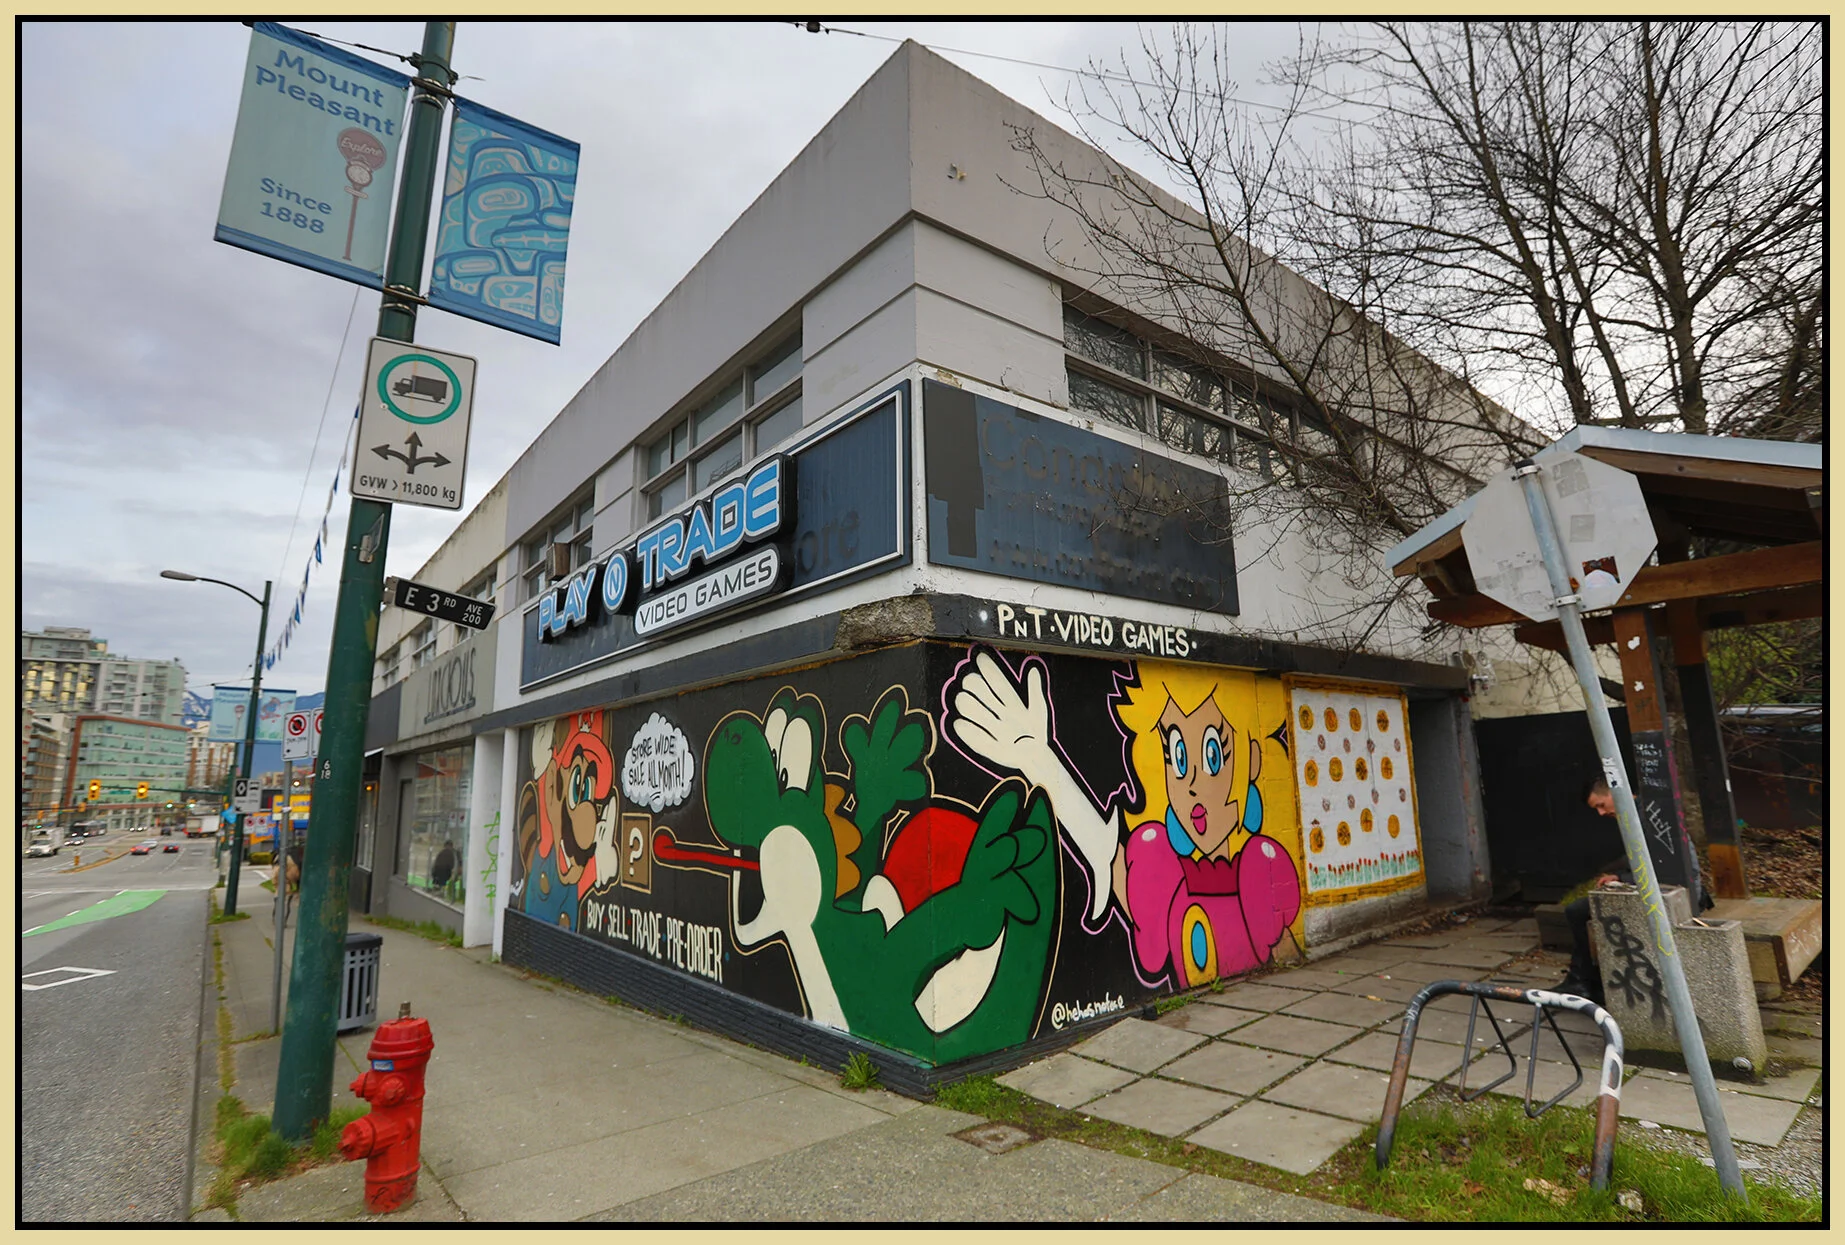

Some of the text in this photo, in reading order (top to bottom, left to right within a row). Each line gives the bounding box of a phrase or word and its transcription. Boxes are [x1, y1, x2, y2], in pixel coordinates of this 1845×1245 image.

[275, 49, 383, 108] Mount
[260, 177, 332, 215] Since
[261, 201, 324, 234] 1888
[360, 475, 388, 490] GVW
[402, 481, 438, 497] 11,800
[443, 488, 455, 502] kg
[538, 566, 598, 641] PLAY
[637, 459, 780, 589] TRADE
[405, 587, 419, 607] E
[465, 604, 483, 616] AVE
[639, 555, 773, 628] VIDEO GAMES
[462, 612, 482, 625] 200
[631, 734, 676, 763] STORE WIDE
[320, 770, 331, 780] 18
[323, 760, 330, 770] 6
[629, 761, 644, 787] SALE
[586, 899, 722, 984] BUY SELL TRADE PRE-ORDER
